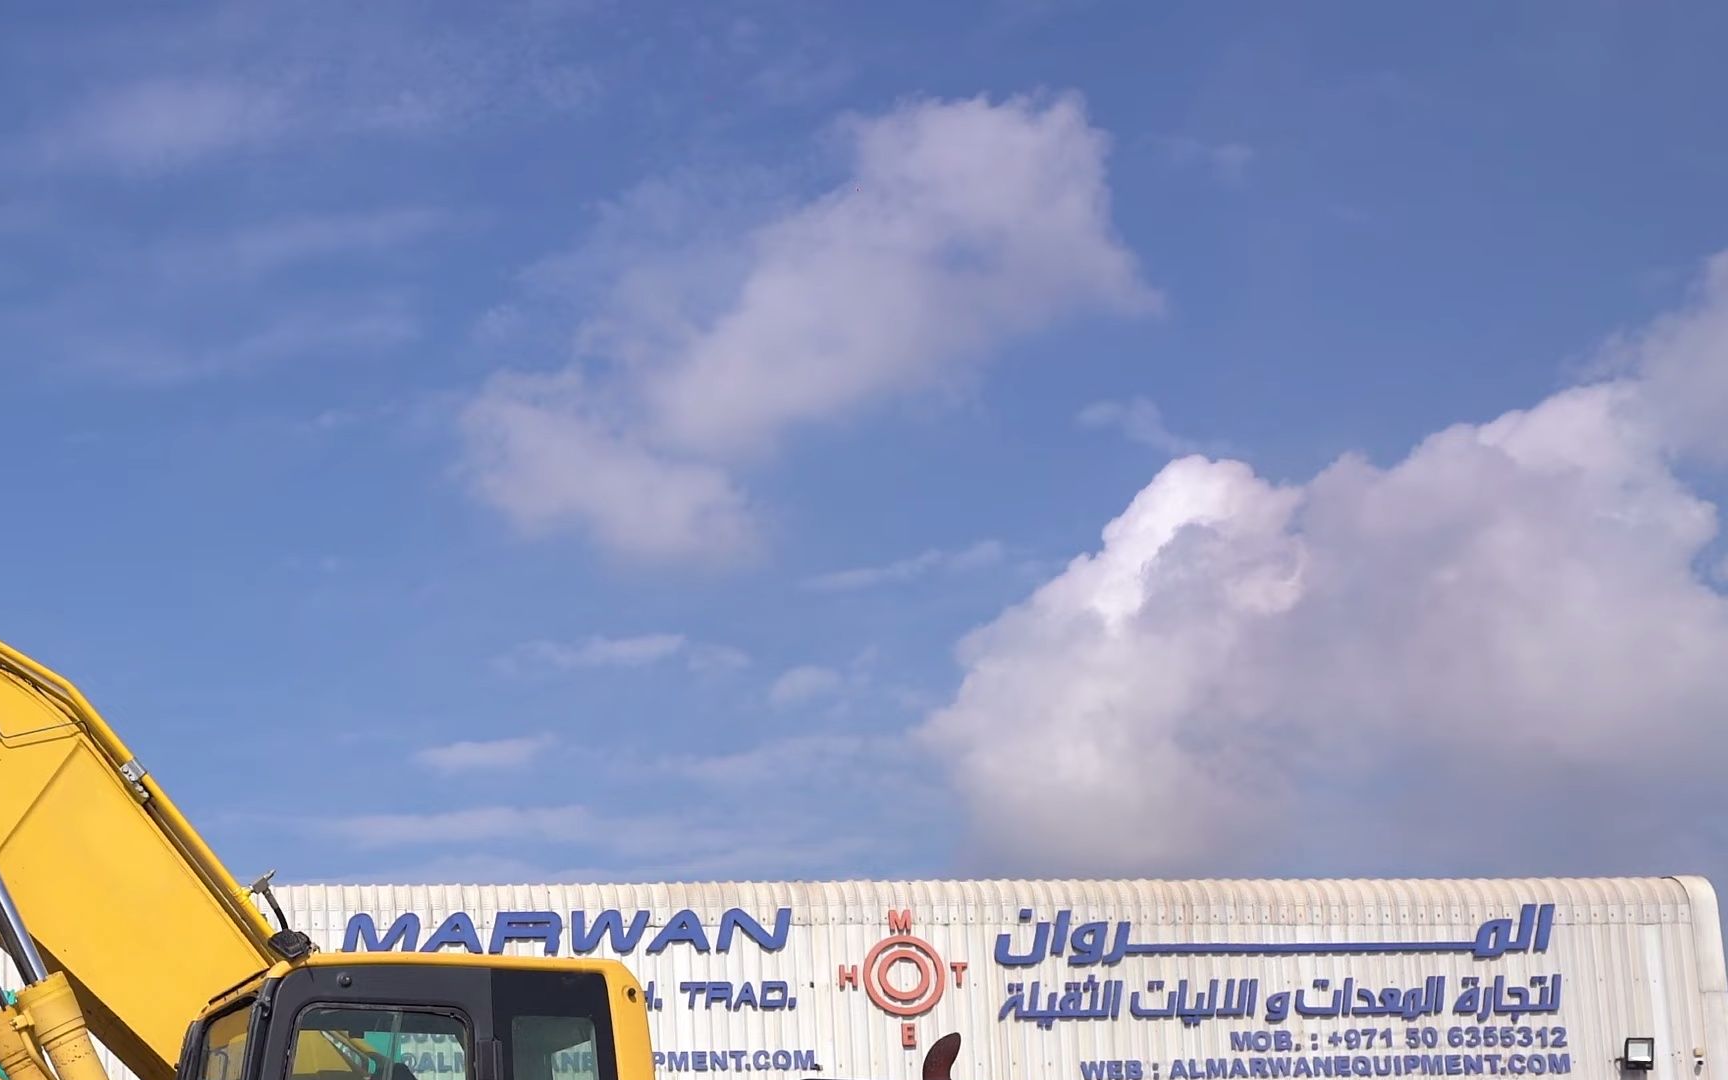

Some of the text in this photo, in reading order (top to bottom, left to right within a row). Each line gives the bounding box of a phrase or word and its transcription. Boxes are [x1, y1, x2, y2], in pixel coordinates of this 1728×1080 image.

[342, 907, 792, 954] MARWAN
[888, 909, 912, 934] M
[679, 980, 798, 1011] TRAD.
[998, 974, 1124, 1030] الثقيلة
[1265, 990, 1291, 1022] و
[1295, 976, 1445, 1022] المعدات
[1453, 974, 1561, 1024] لتجارة
[1230, 1030, 1302, 1052] MOB.
[1328, 1028, 1393, 1050] +971
[1405, 1028, 1438, 1049] 50
[1447, 1027, 1568, 1049] 6355312
